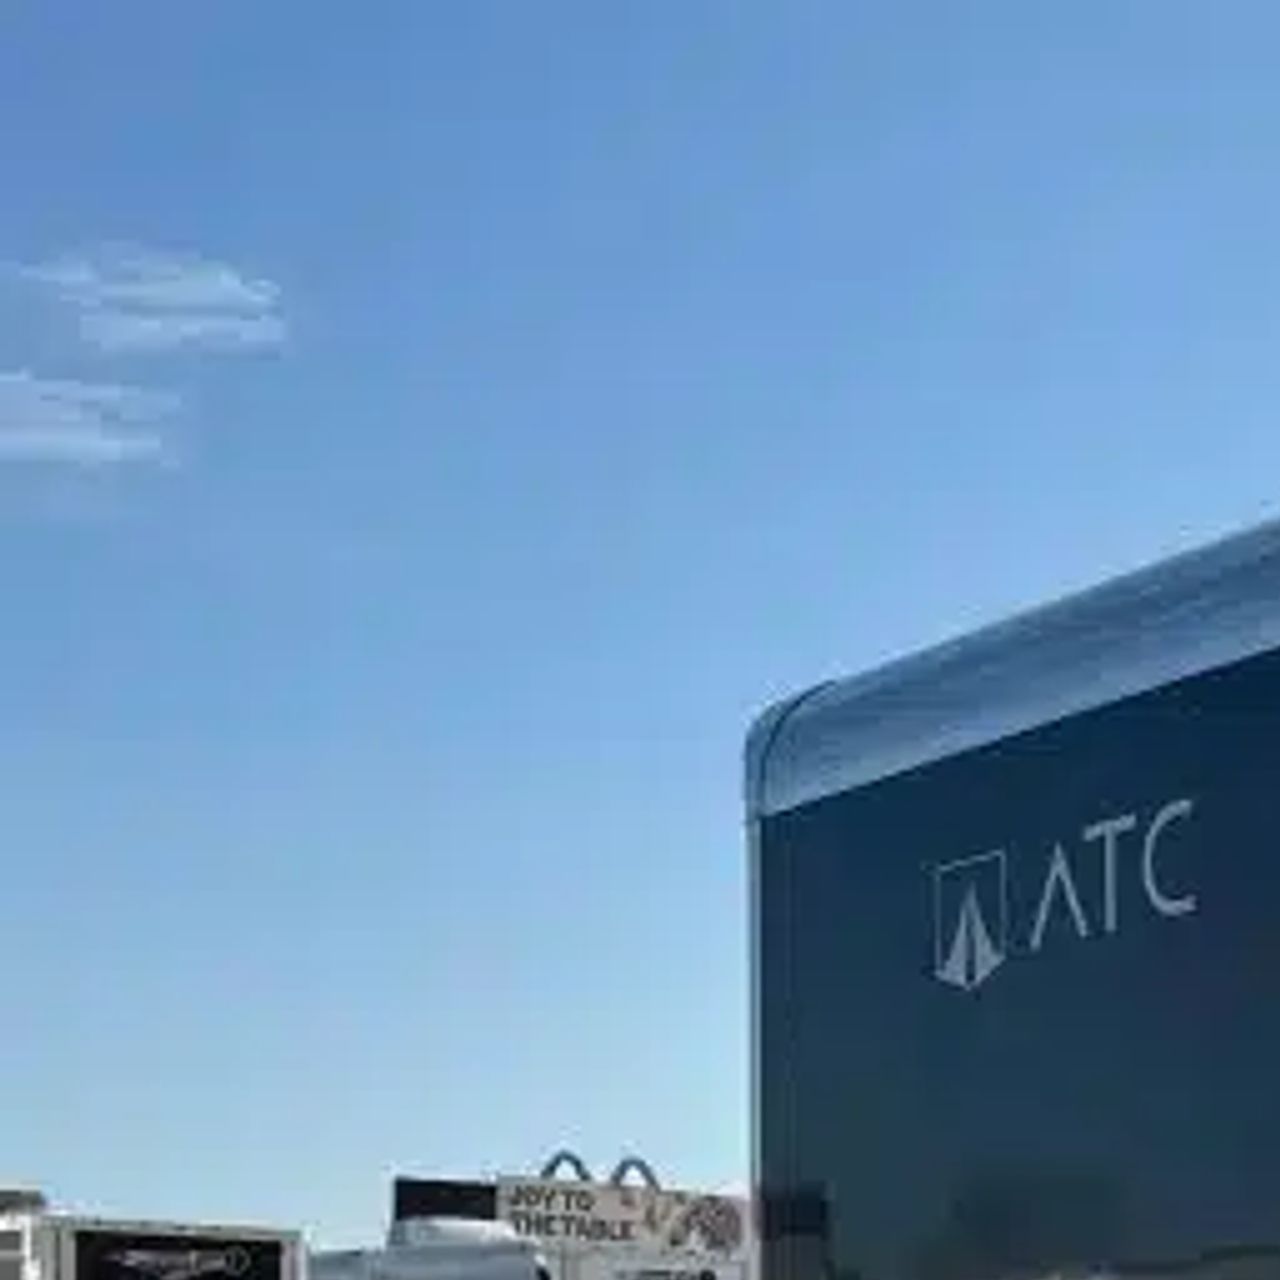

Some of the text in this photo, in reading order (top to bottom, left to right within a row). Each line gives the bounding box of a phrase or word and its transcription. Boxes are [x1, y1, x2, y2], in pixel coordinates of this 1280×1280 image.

[1030, 799, 1197, 951] ATC
[509, 1185, 595, 1211] JOY TO
[511, 1211, 556, 1237] THE
